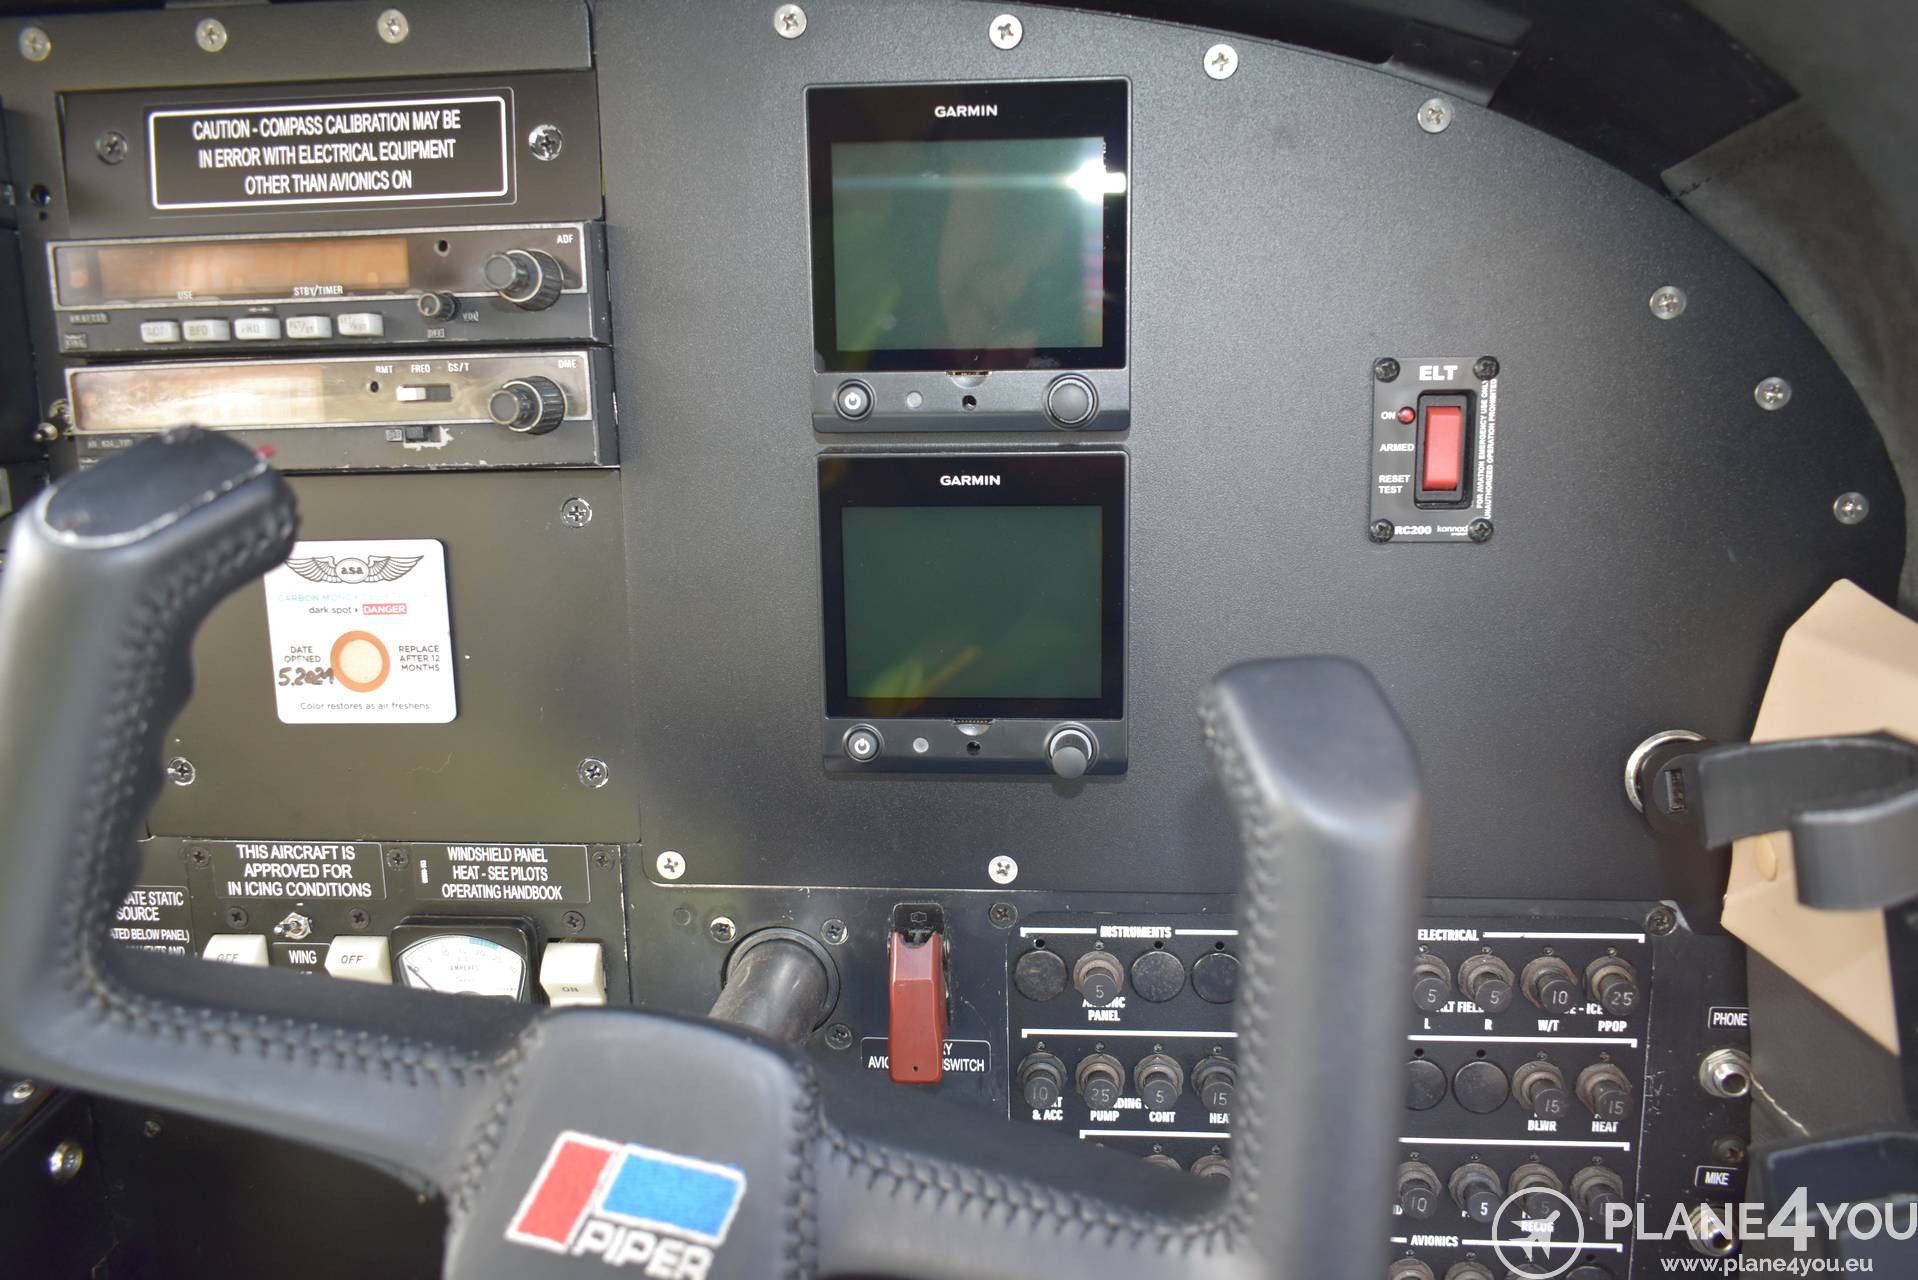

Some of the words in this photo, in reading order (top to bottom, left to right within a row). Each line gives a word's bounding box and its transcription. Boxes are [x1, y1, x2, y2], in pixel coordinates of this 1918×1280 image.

[934, 104, 998, 118] GARMIN
[193, 119, 250, 141] CAUTION
[260, 116, 323, 138] COMPASS
[325, 112, 410, 135] CALIBRATION
[412, 111, 441, 131] MAY
[443, 109, 460, 130] BE
[199, 149, 215, 169] IN
[217, 146, 260, 168] ERROR
[262, 145, 297, 166] WITH
[300, 141, 378, 165] ELECTRICAL
[380, 139, 456, 161] EQUIPMENT
[244, 175, 290, 196] OTHER
[293, 173, 326, 193] THAN
[326, 171, 389, 192] AVIONICS
[392, 170, 412, 190] ON
[557, 234, 574, 244] ADF
[176, 290, 193, 300] USE
[293, 284, 344, 297] STBY/TIMER
[375, 365, 393, 374] RMT
[411, 364, 431, 374] FREQ
[447, 362, 470, 373] GS/T
[557, 359, 577, 369] DME
[1419, 365, 1458, 381] ELT
[1480, 399, 1488, 415] USE
[1381, 411, 1396, 420] ON
[1478, 415, 1487, 460] EMERGENCY
[1380, 443, 1415, 452] ARMED
[1484, 464, 1493, 519] UNAUTHORIZED
[1489, 378, 1497, 422] PROHIBITED
[940, 474, 1000, 486] GARMIN
[1379, 475, 1411, 483] RESET
[1477, 461, 1485, 493] AVIATION
[1379, 486, 1403, 494] TEST
[1394, 526, 1432, 535] RC200
[341, 566, 364, 575] asa
[309, 606, 329, 614] dark
[331, 606, 352, 615] spot
[363, 604, 406, 614] DANGER
[290, 646, 313, 654] DATE
[398, 645, 440, 653] REPLACE
[401, 664, 440, 672] MONTHS
[300, 702, 325, 710] Color
[327, 702, 363, 710] restores
[378, 702, 389, 710] air
[391, 702, 430, 710] freshens
[236, 844, 269, 860] THIS
[270, 845, 339, 860] AIRCRAFT
[341, 846, 355, 861] IS
[447, 847, 512, 862] WINDSHIELD
[514, 848, 549, 863] PANEL
[244, 863, 320, 878] APPROVED
[322, 864, 353, 879] FOR
[453, 865, 480, 880] HEAT
[488, 866, 509, 881] SEE
[512, 866, 548, 881] PILOTS
[227, 881, 240, 896] IN
[244, 882, 283, 897] ICING
[285, 882, 372, 898] CONDITIONS
[442, 884, 501, 899] OPERATING
[503, 885, 563, 900] HANDBOOK
[148, 891, 184, 906] STATIC
[131, 929, 159, 940] BELOW
[161, 929, 190, 943] PANEL)
[1100, 926, 1172, 938] INSTRUMENTS
[1417, 929, 1480, 941] ELECTRICAL
[289, 950, 317, 964] WING
[340, 955, 363, 964] OFF
[1096, 985, 1104, 998] 5
[1427, 989, 1438, 1003] 5
[1490, 990, 1500, 1004] 5
[1552, 990, 1568, 1005] 10
[1611, 992, 1633, 1006] 25
[1088, 1010, 1120, 1021] PANEL
[1713, 1012, 1748, 1026] PHONE
[1424, 1018, 1431, 1030] L
[1484, 1019, 1493, 1030] R
[1538, 1019, 1559, 1031] W/T
[943, 1058, 984, 1072] SWITCH
[1032, 1087, 1048, 1101] 10
[1091, 1088, 1110, 1102] 25
[1155, 1090, 1165, 1104] 5
[1212, 1092, 1228, 1106] 15
[1114, 1098, 1142, 1109] DING
[1544, 1099, 1560, 1114] 15
[1608, 1100, 1624, 1115] 15
[1043, 1110, 1064, 1120] ACC
[1090, 1111, 1120, 1121] PUMP
[1149, 1112, 1176, 1123] CONT
[1209, 1113, 1230, 1123] HEA
[1527, 1120, 1557, 1131] BLWR
[1591, 1121, 1619, 1133] HEAT
[1704, 1172, 1729, 1185] MIKE
[1411, 1198, 1427, 1213] 10
[1480, 1202, 1489, 1216] 5
[1410, 1235, 1459, 1247] AVIONICS
[571, 1219, 714, 1280] PIPER
